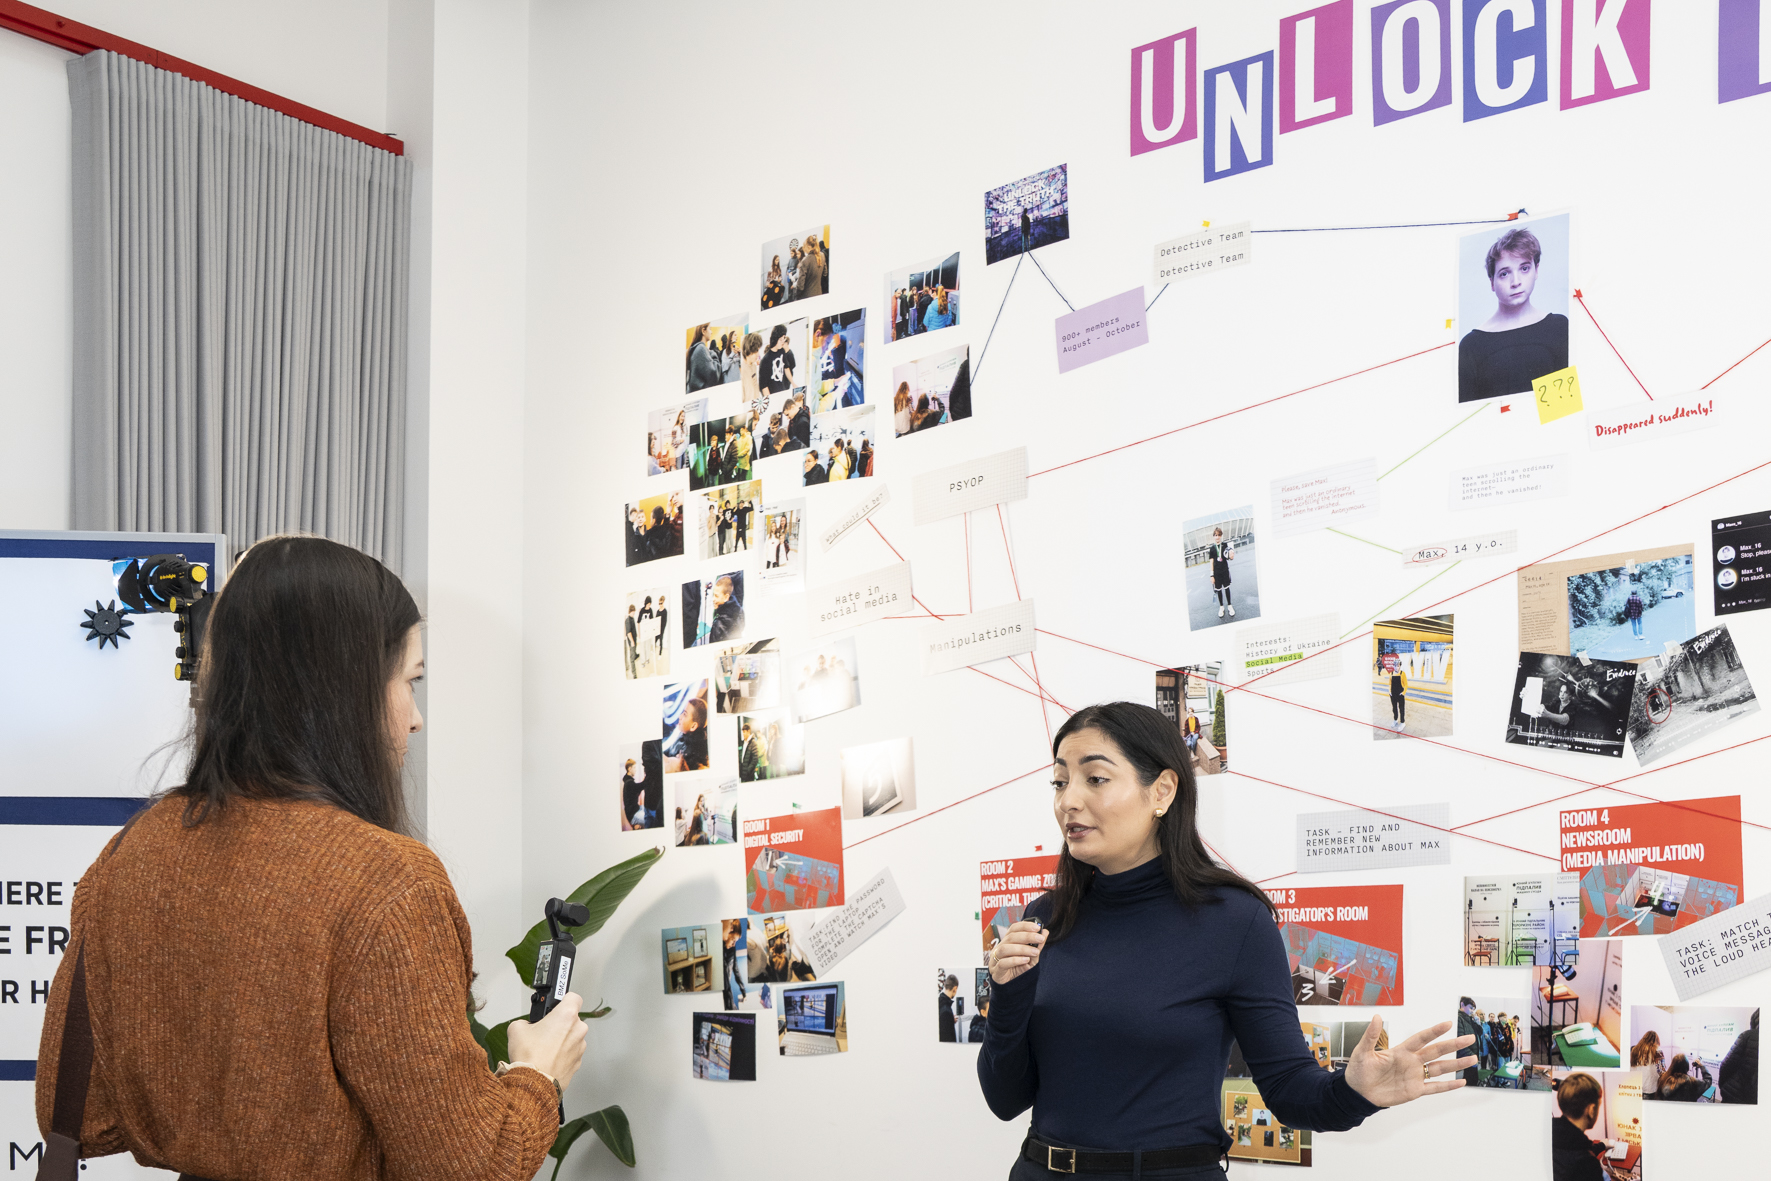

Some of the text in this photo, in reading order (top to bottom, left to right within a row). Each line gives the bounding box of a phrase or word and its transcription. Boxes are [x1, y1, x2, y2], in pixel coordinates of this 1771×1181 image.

[1140, 0, 1639, 173] UNLOCK
[1004, 179, 1047, 201] UNLOCK
[1020, 187, 1054, 206] TRUTH
[1160, 230, 1244, 257] Detective Team
[1160, 252, 1244, 278] Detective Team
[1062, 316, 1120, 343] 900+ members
[1062, 338, 1091, 354] August
[1105, 320, 1141, 338] October
[1594, 400, 1713, 437] Disappeared suddenly!
[1492, 470, 1507, 478] just
[1522, 464, 1555, 473] ordinary
[949, 475, 984, 493] PSYOP
[1301, 481, 1314, 489] save
[1480, 476, 1515, 486] scrolling
[1418, 540, 1503, 559] Max, 14 y.o.
[1739, 542, 1762, 551] Max_16
[1740, 550, 1755, 559] Stop,
[1741, 566, 1763, 575] Max_16
[835, 585, 880, 605] Hate in
[820, 592, 898, 622] social media
[929, 623, 1023, 654] Manipulations
[1246, 636, 1291, 649] Interests:
[1246, 639, 1331, 658] History of Ukraine
[1246, 653, 1303, 668] Social Media
[1247, 667, 1275, 677] Sports
[744, 818, 770, 834] ROOM 1
[1561, 809, 1610, 828] ROOM 4
[744, 829, 804, 849] DIGITAL SECURITY
[1306, 828, 1330, 837] TASK
[1349, 825, 1375, 834] FIND
[1380, 823, 1400, 832] AND
[1561, 827, 1632, 849] NEWSROOM
[1306, 835, 1381, 847] REMEMBER NEW
[1306, 841, 1441, 857] INFORMATION ABOUT MAX
[1562, 843, 1705, 871] (MEDIA MANIPULATION)
[981, 860, 1014, 876] ROOM 2
[981, 878, 1007, 892] MAX'S
[1007, 874, 1042, 890] GAMING
[0, 881, 63, 905] ERE
[842, 904, 854, 915] THE
[856, 878, 885, 904] PASSWORD
[982, 893, 1022, 911] (CRITICAL
[1288, 890, 1296, 904] 3
[1336, 906, 1369, 921] ROOM
[811, 907, 860, 949] FOR THE LAPTOP
[814, 897, 884, 957] COMPLETE THE CAPTCHA
[816, 904, 887, 963] OPEN AND WATCH MAX'S
[1675, 919, 1760, 958] TASK: MATCH
[819, 951, 838, 968] VIDEO
[1679, 947, 1717, 968] VOICE
[1683, 964, 1706, 978] THE
[1713, 949, 1744, 967] LOUD
[557, 960, 569, 996] BMZ SoMe
